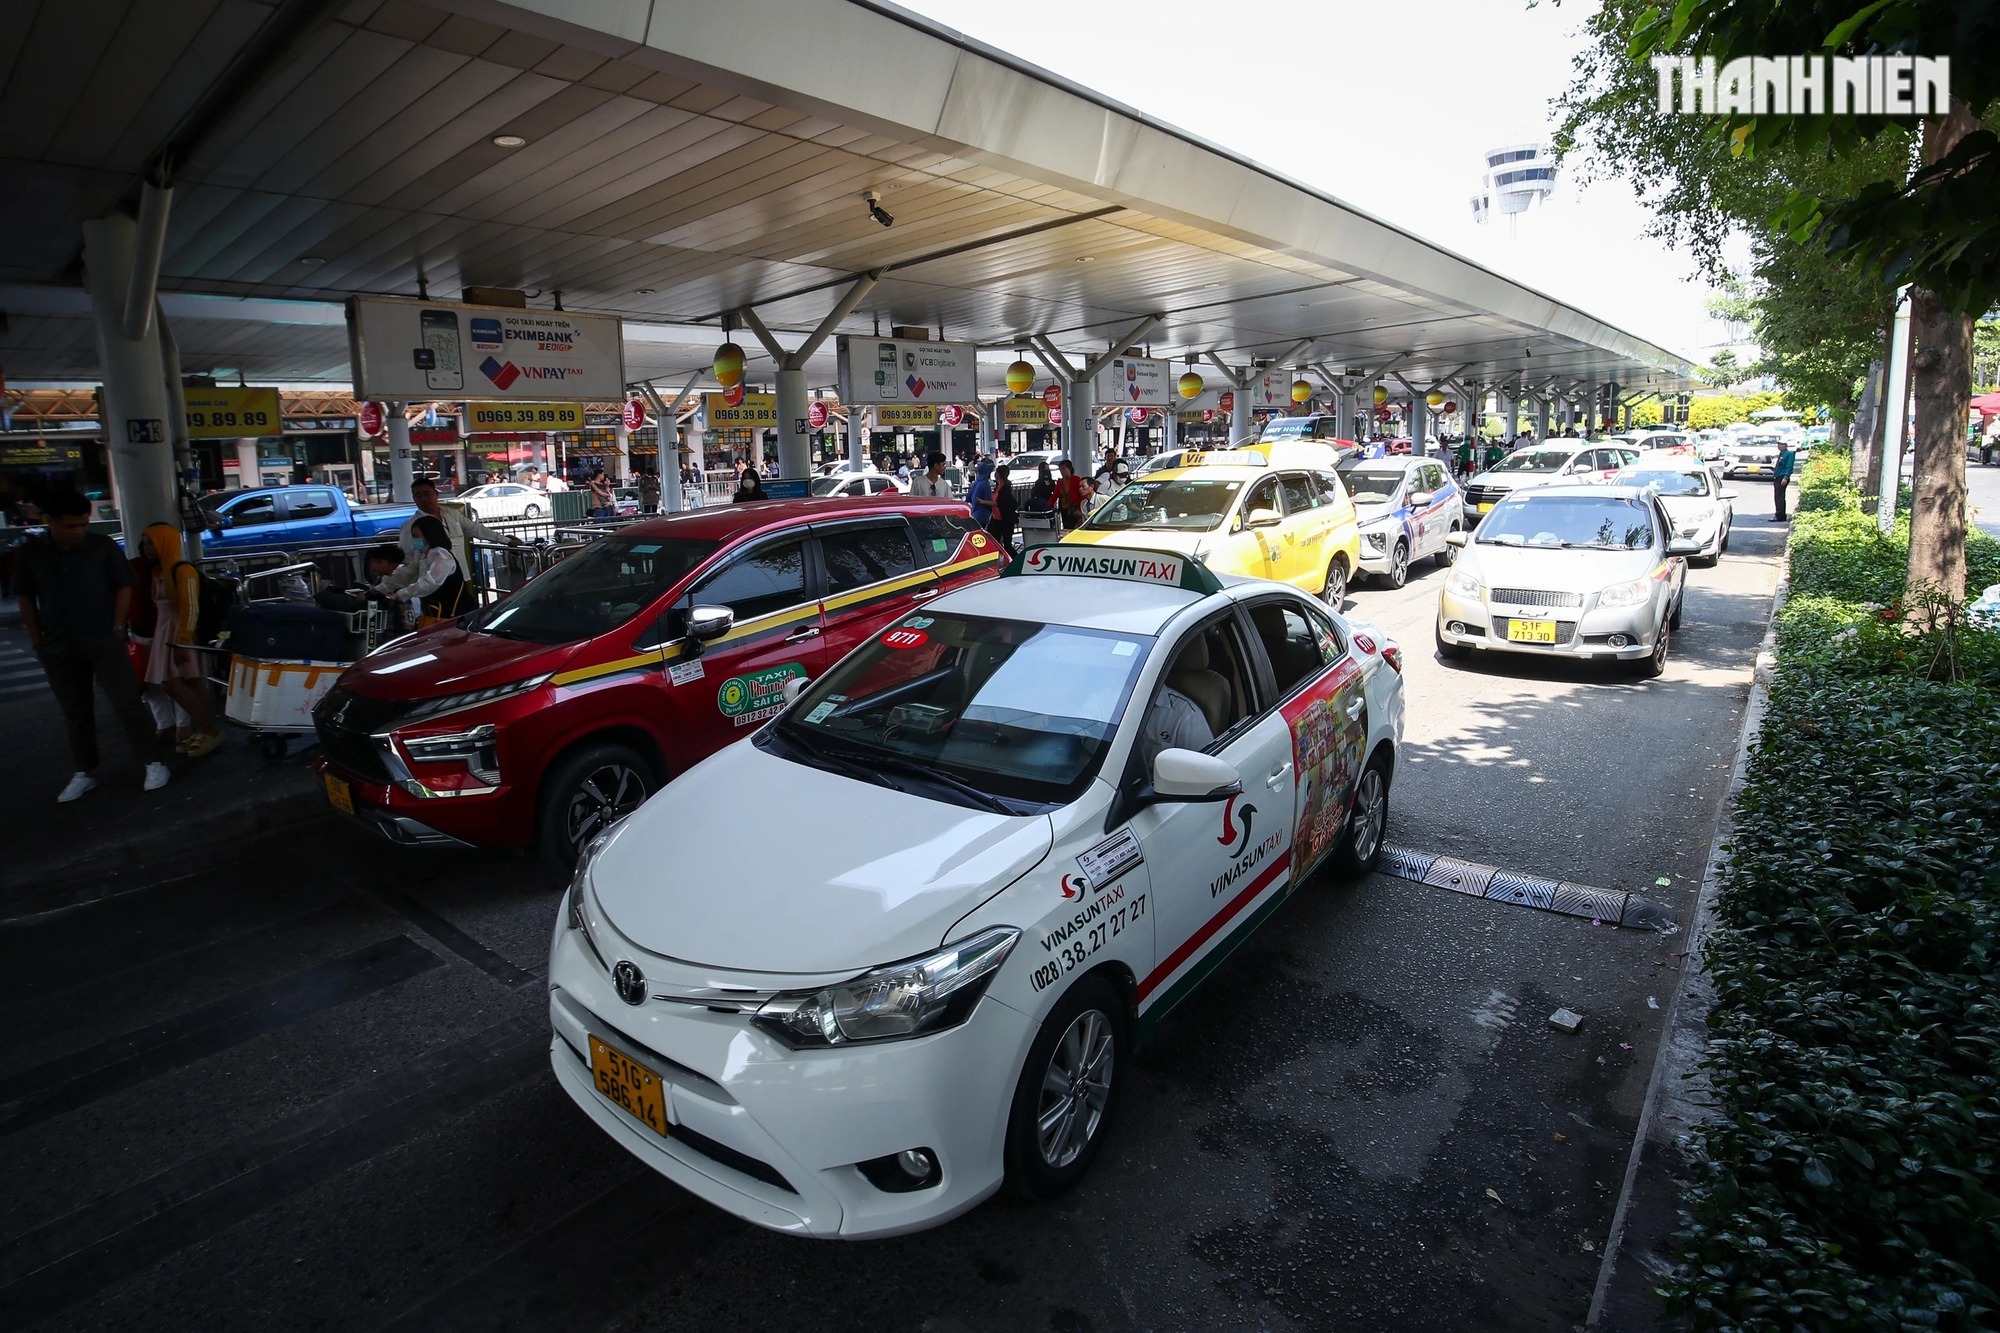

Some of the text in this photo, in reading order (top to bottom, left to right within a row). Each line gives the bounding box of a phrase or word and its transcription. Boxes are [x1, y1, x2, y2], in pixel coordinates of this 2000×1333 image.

[506, 318, 519, 326] GỌI
[520, 318, 535, 326] TAXI
[554, 320, 570, 328] TRÊN
[505, 329, 574, 344] EXIMBANK
[545, 343, 568, 351] EDIGI
[477, 410, 576, 423] 0969.39.89.89
[882, 410, 933, 420] 0969.39.89.89
[128, 420, 163, 443] C-13
[1522, 621, 1542, 631] 51F
[887, 631, 921, 645] 9711
[1513, 631, 1551, 642] 713.30
[756, 670, 787, 682] TAXI
[753, 696, 771, 708] SÀI
[736, 711, 756, 725] 0912
[757, 709, 767, 719] 32
[768, 706, 778, 716] 42
[1110, 909, 1128, 938] 27
[1130, 893, 1147, 922] 27
[608, 1051, 642, 1091] 51G
[599, 1070, 658, 1128] 586.14
